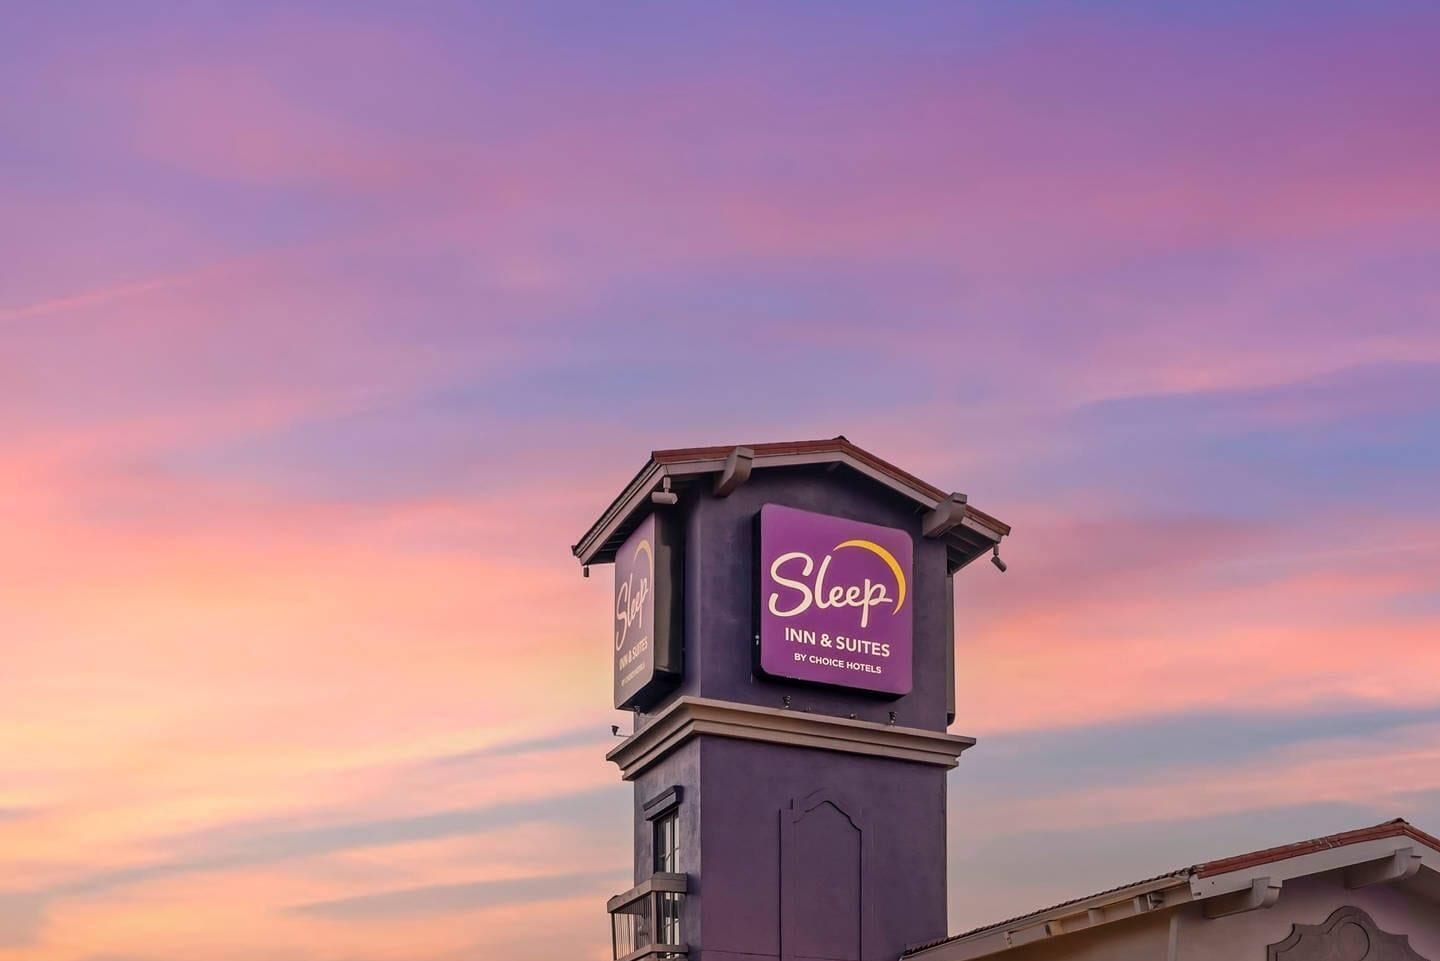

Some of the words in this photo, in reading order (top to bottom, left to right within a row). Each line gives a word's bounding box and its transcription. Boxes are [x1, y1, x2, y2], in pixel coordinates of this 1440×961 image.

[616, 573, 649, 651] Sleep
[769, 552, 893, 628] Sleep
[785, 627, 816, 645] INN
[820, 633, 833, 648] &
[836, 636, 890, 657] SUITES
[794, 652, 807, 662] BY
[809, 655, 844, 668] CHOICE
[846, 661, 882, 674] HOTELS
